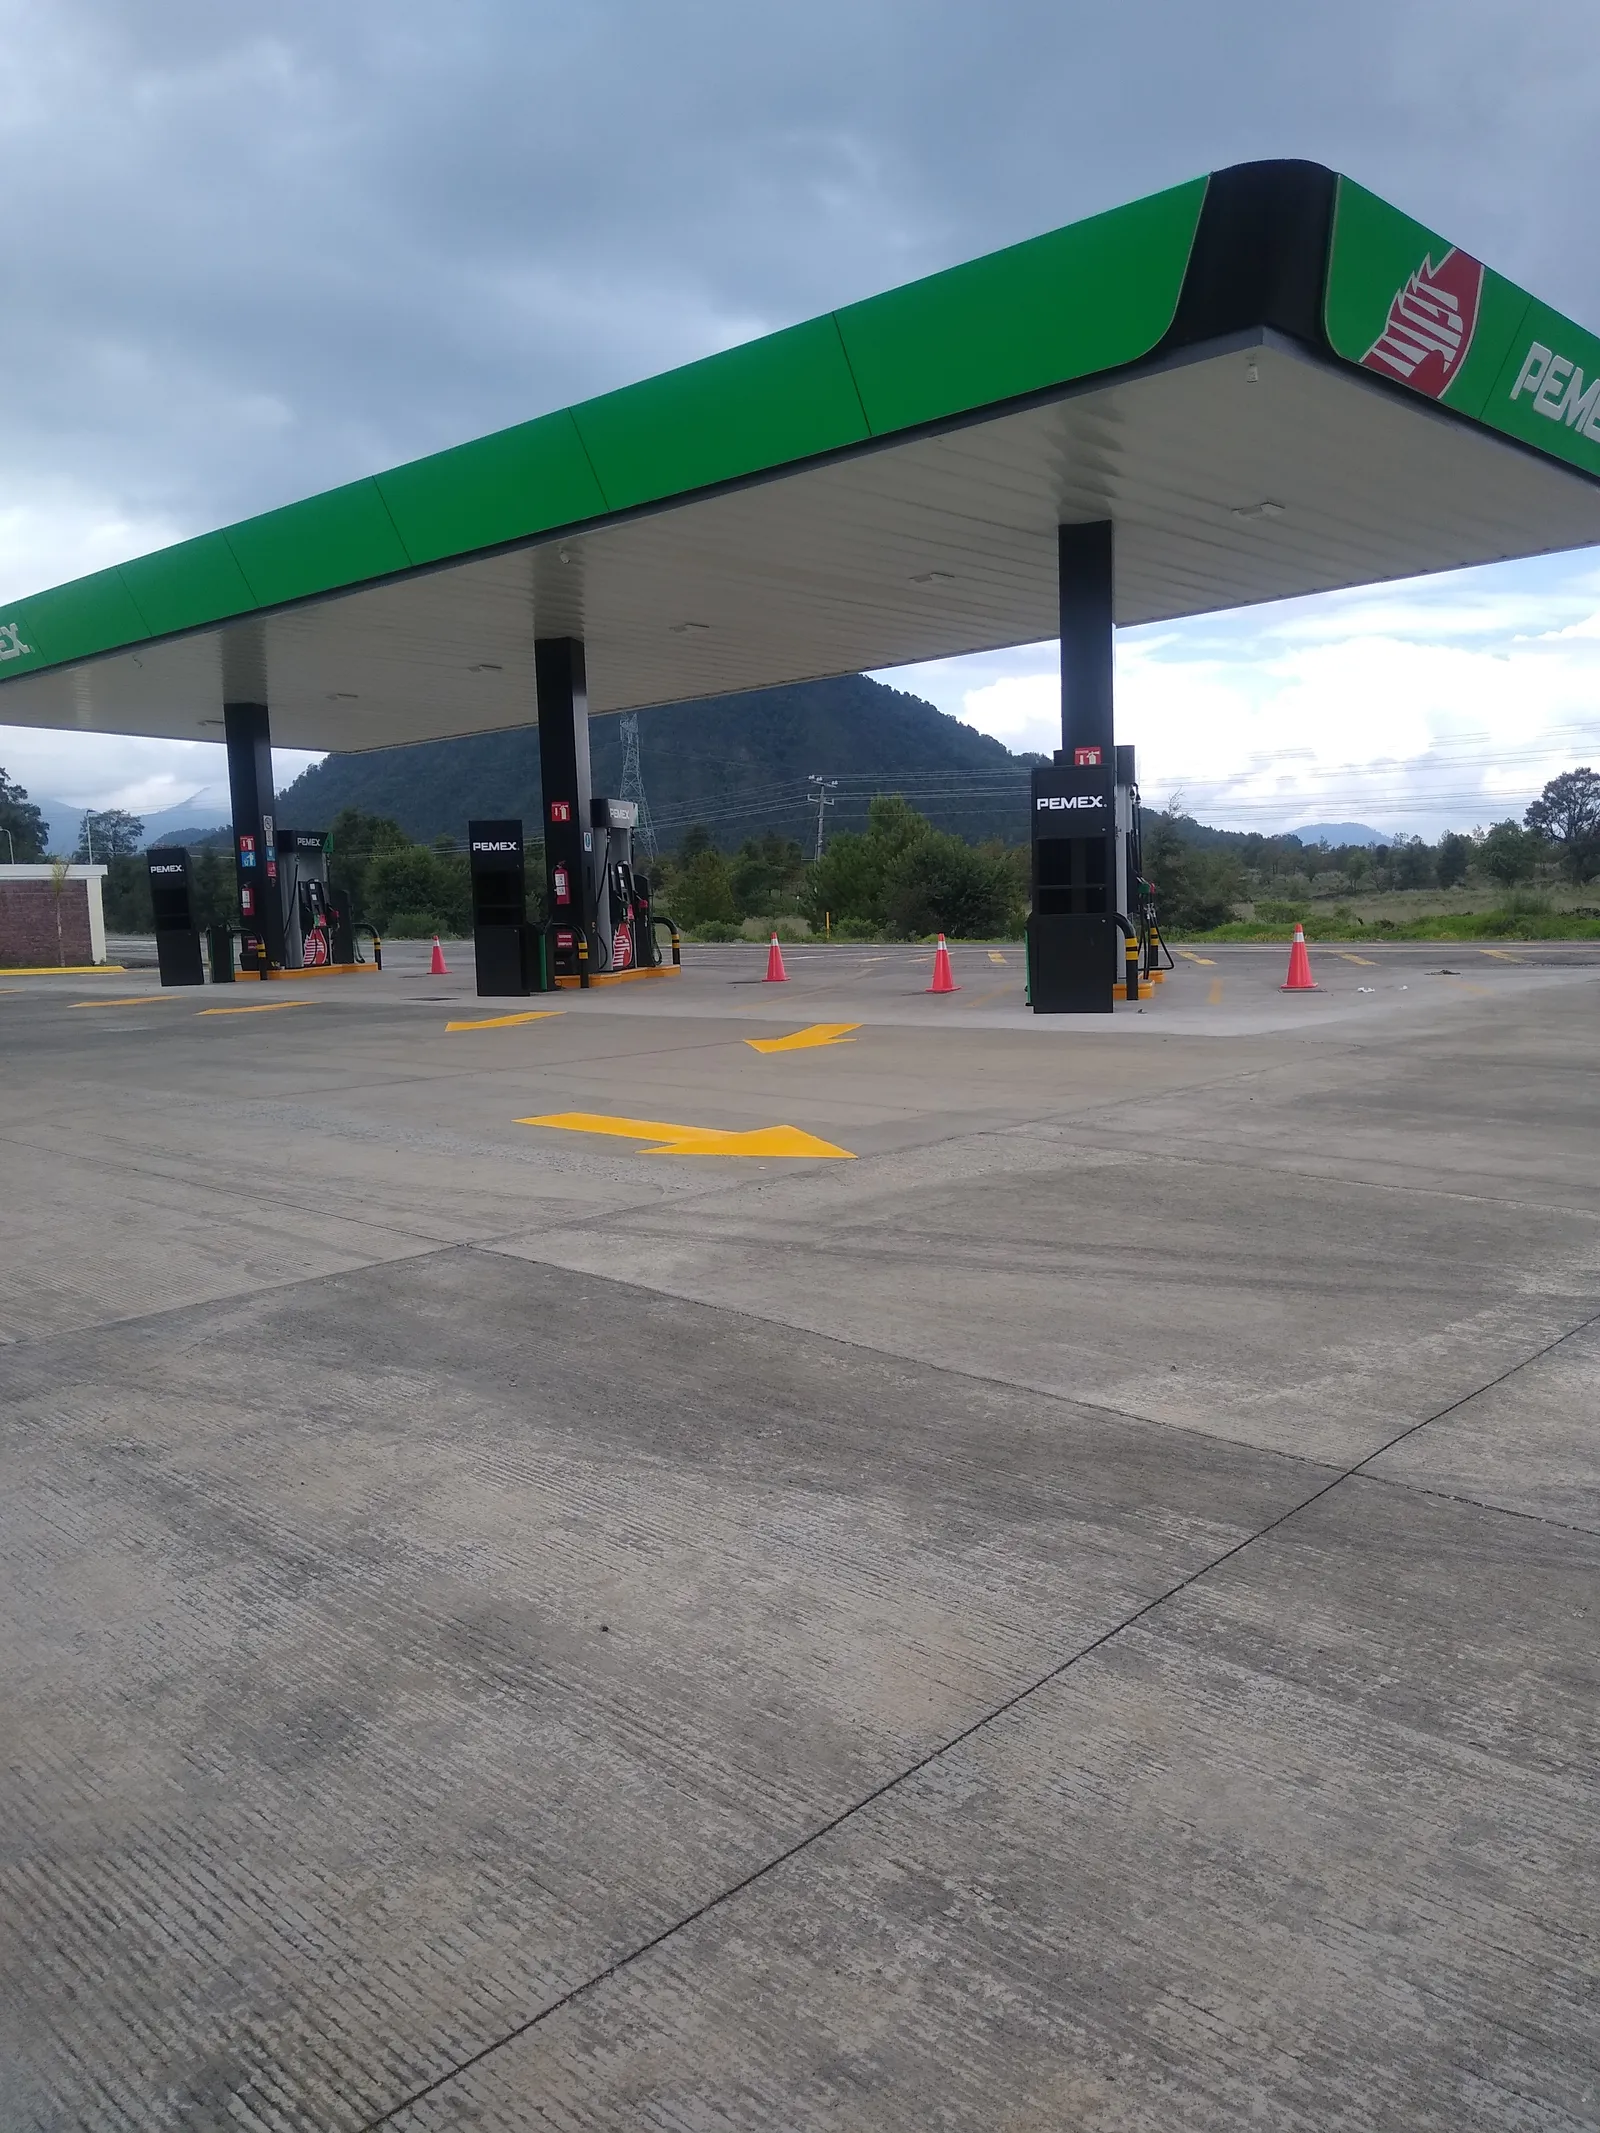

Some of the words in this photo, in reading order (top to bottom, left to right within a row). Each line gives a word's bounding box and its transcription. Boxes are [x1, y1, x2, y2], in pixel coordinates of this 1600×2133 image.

[1037, 796, 1103, 810] PEMEX
[297, 837, 321, 846] PEMEX
[473, 842, 517, 851] PEMEX
[150, 865, 182, 873] PEMEX
